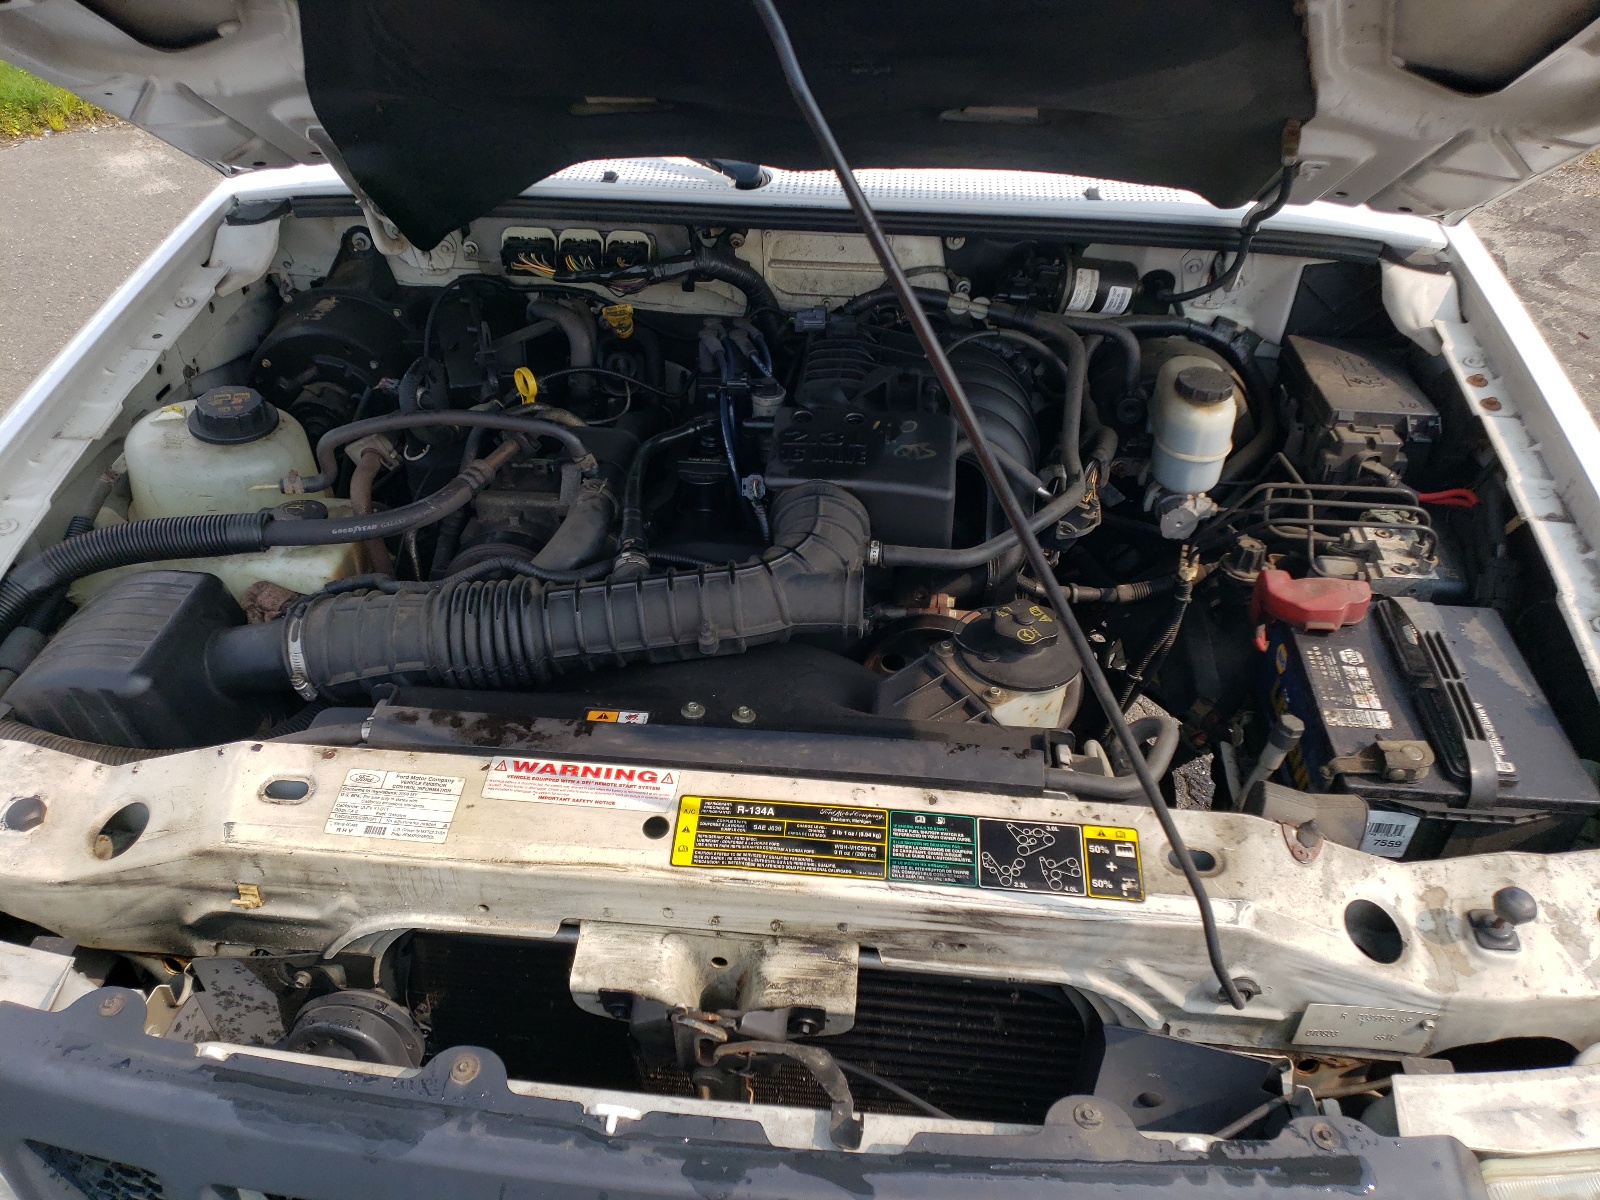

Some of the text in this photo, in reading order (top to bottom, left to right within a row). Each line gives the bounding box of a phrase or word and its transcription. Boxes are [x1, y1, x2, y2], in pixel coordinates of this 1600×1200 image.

[332, 517, 407, 534] GOODYEAR GALAXY
[512, 760, 658, 784] WARNING
[356, 774, 374, 782] Ford
[737, 806, 775, 816] R-134A
[1089, 844, 1110, 854] 50%
[1374, 840, 1402, 848] 7559
[1092, 879, 1113, 889] 50%
